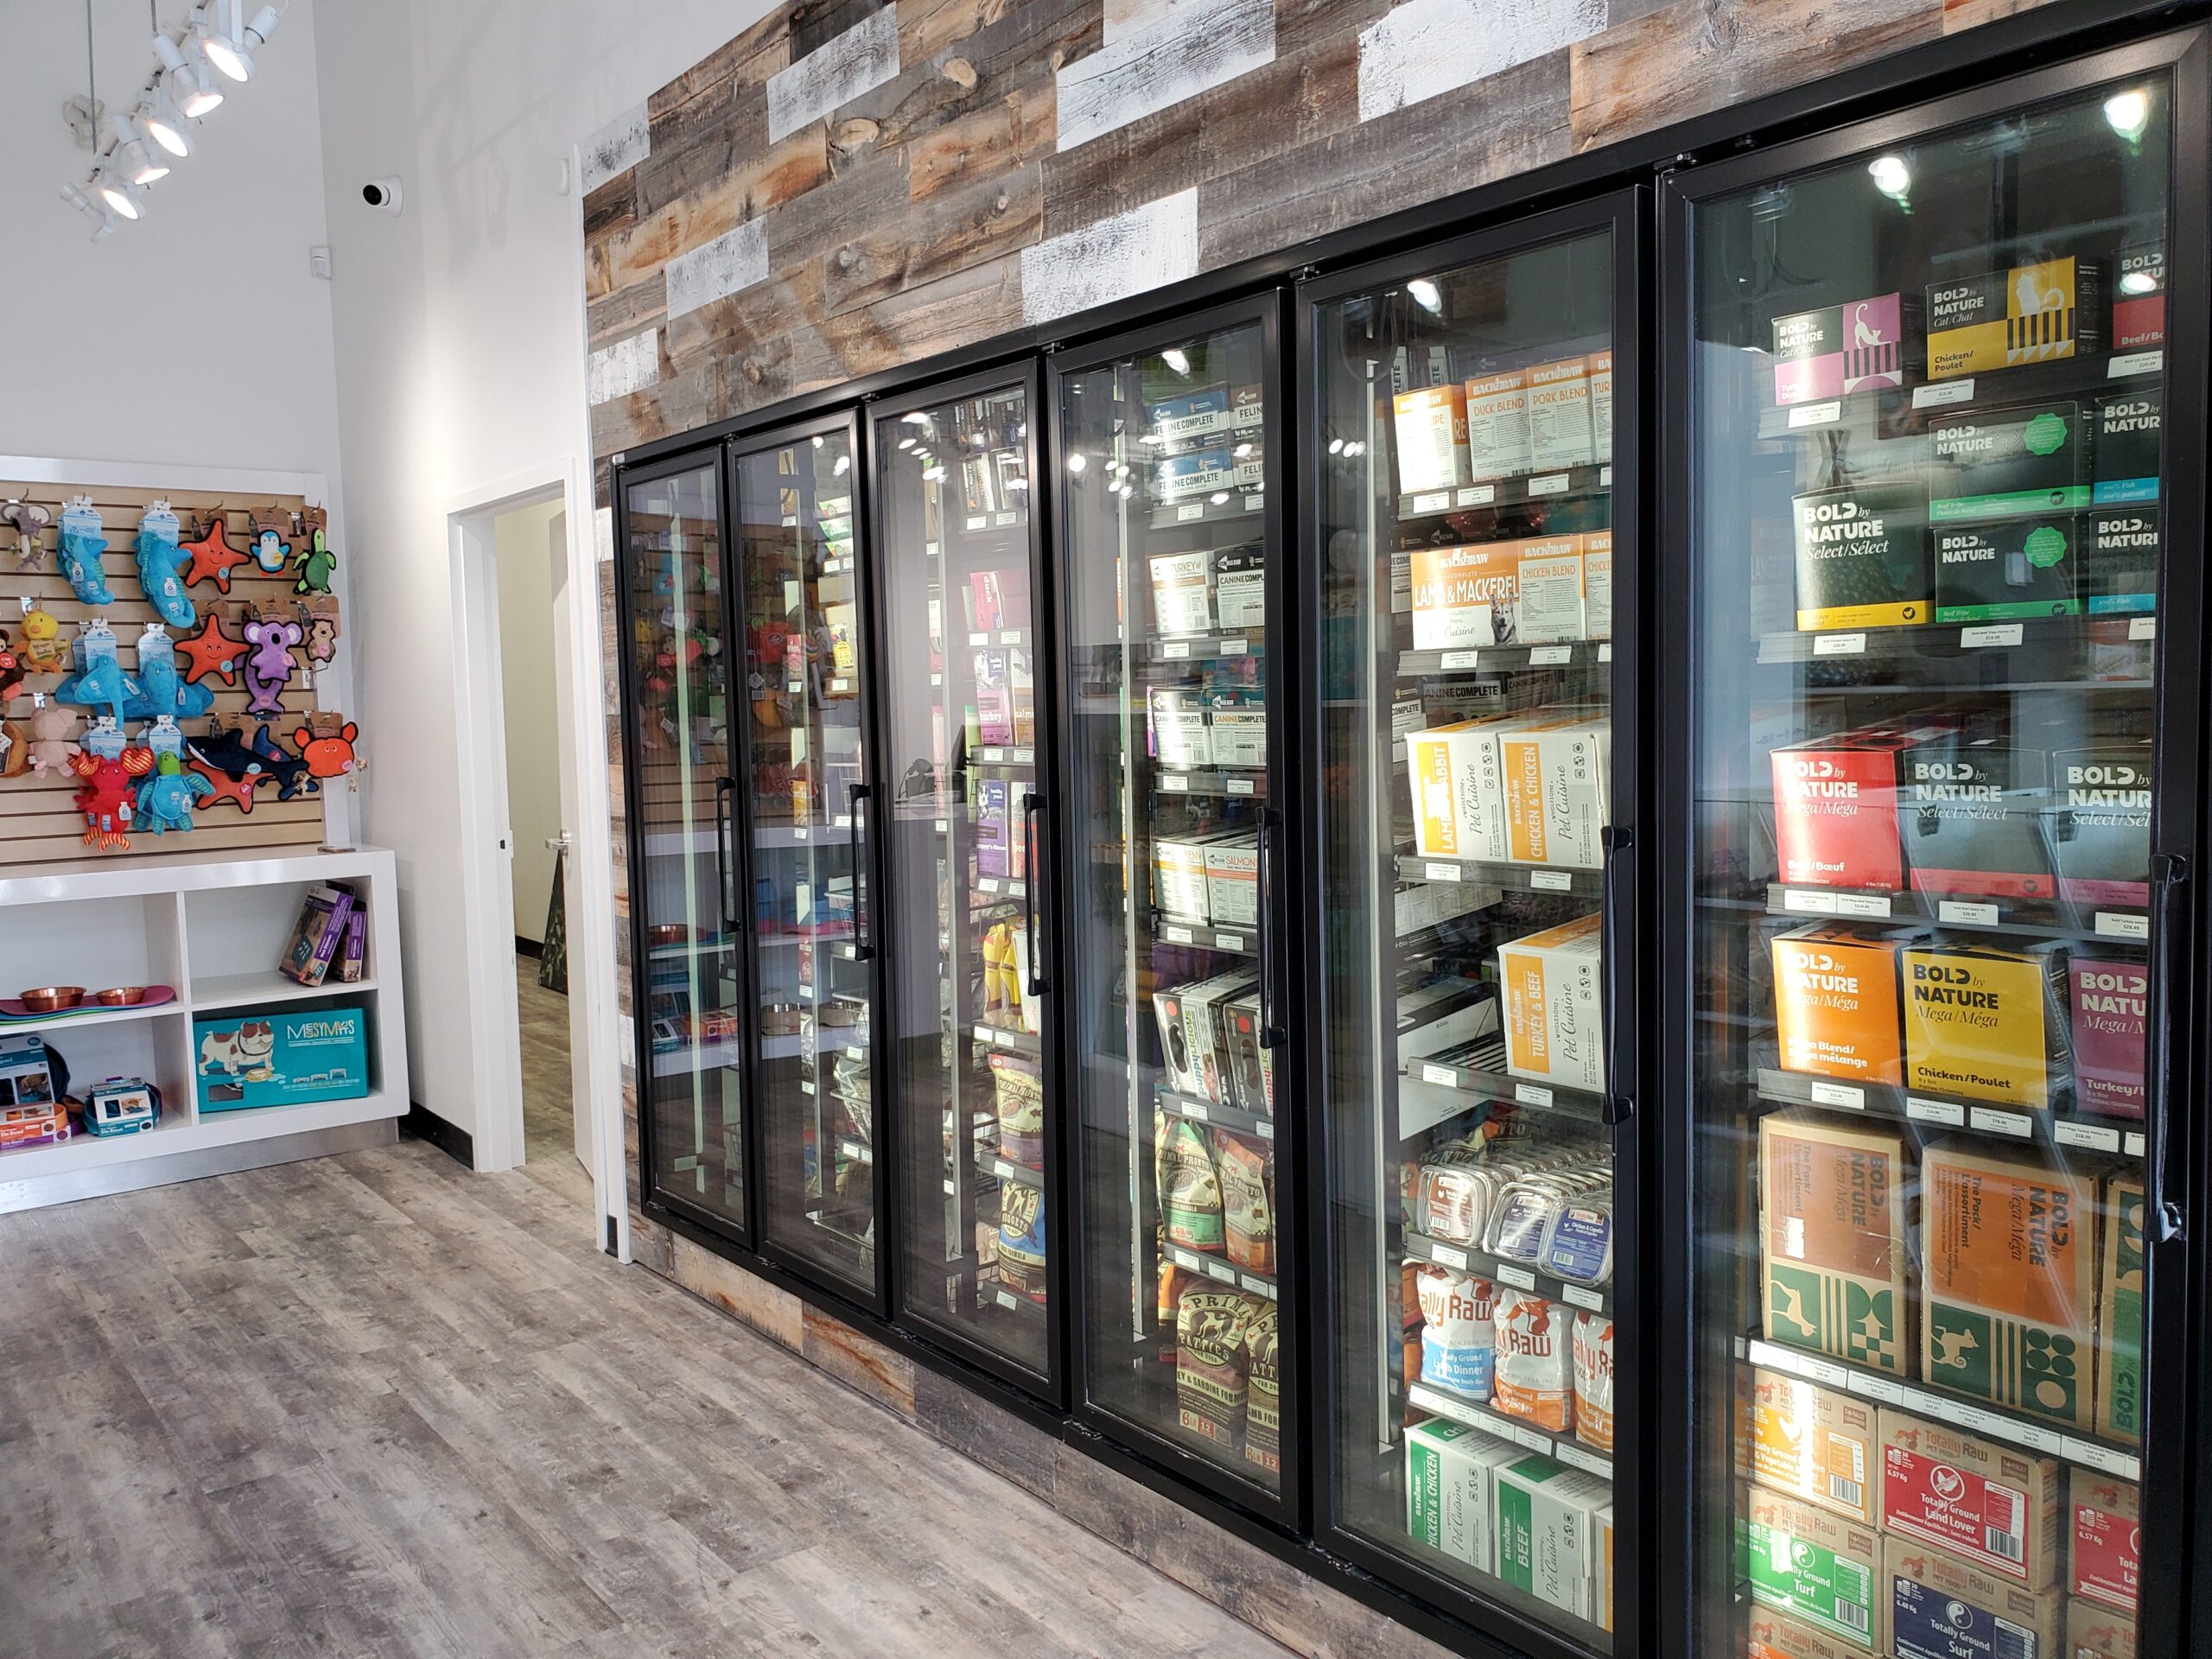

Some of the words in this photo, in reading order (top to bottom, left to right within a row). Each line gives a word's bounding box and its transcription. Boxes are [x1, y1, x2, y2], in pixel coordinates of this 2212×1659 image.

[2122, 253, 2163, 270] BOLD
[1934, 288, 1968, 304] BOLD
[1934, 296, 1985, 316] NATURE
[1779, 322, 1809, 336] BOLD
[1934, 313, 1973, 327] Cat/Chat
[1780, 331, 1823, 348] NATURE
[1935, 350, 1973, 364] Chicken/
[1935, 361, 1963, 372] Poulet
[1533, 391, 1557, 405] PORK
[1559, 386, 1588, 402] BLEND
[1474, 401, 1494, 416] DUCK
[1497, 397, 1524, 413] BLEND
[2104, 402, 2149, 418] BOLD
[2150, 404, 2160, 414] by
[1937, 426, 1975, 442] BOLD
[1936, 436, 1993, 455] NATURE
[1803, 502, 1857, 524] BOLD
[1858, 507, 1871, 518] by
[1803, 519, 1884, 544] NATURE
[2098, 519, 2143, 534] BOLD
[2144, 522, 2152, 531] by
[1805, 539, 1890, 561] Select/Sélect
[1942, 535, 1979, 550] BOLD
[1980, 538, 1987, 547] by
[1942, 548, 1996, 563] NATURE
[1522, 567, 1550, 580] CHICKEN
[1552, 564, 1576, 577] BLEND
[1447, 587, 1456, 604] &
[1457, 575, 1519, 603] MACKEREL
[1445, 626, 1476, 638] Cuisine
[980, 711, 1002, 722] turkey
[1524, 747, 1538, 794] CHICKEN
[1834, 769, 1846, 779] by
[1915, 762, 1974, 780] BOLD
[1974, 769, 1988, 782] by
[2067, 766, 2135, 784] BOLD
[2137, 774, 2152, 785] by
[1466, 763, 1479, 811] Cuisine
[1556, 765, 1569, 814] Cuisine
[1916, 785, 2002, 803] NATURE
[1917, 804, 2007, 820] Select/Sélect
[1470, 815, 1483, 835] Pet
[1529, 810, 1542, 857] CHICKEN
[1559, 817, 1573, 839] Pet
[1226, 855, 1255, 867] SALMON
[1834, 962, 1846, 974] by
[1913, 964, 1970, 984] BOLD
[1972, 976, 1986, 988] by
[1528, 970, 1540, 1000] BEEF
[2081, 971, 2146, 994] BOLD
[1915, 986, 1999, 1009] NATURE
[1560, 982, 1576, 1035] Cuisine
[1916, 1005, 1999, 1028] Mega/Méga
[1531, 1020, 1545, 1058] TURKEY
[1818, 1040, 1855, 1054] Blend/
[1562, 1037, 1579, 1062] Pet
[1820, 1054, 1867, 1068] mélange
[1917, 1066, 2011, 1089] Chicken/Poulet
[1183, 1154, 1210, 1169] PRONTO
[1851, 1152, 1866, 1227] NATURE
[1972, 1176, 1982, 1193] The
[1961, 1173, 1971, 1249] L'assortiment
[1972, 1195, 1982, 1230] Pack/
[2051, 1190, 2069, 1247] BOLD
[1001, 1213, 1028, 1232] NUGGETS
[2010, 1183, 2025, 1262] Mega/Méga
[2029, 1186, 2046, 1268] NATURE
[1448, 1295, 1491, 1321] Raw
[1179, 1333, 1230, 1362] PATTIES
[1510, 1329, 1552, 1357] Raw
[1458, 1354, 1482, 1363] Ground
[1453, 1363, 1484, 1376] Dinner
[1187, 1374, 1192, 1383] &
[1192, 1377, 1220, 1398] SARDINE
[1182, 1411, 1190, 1425] 6
[1199, 1421, 1211, 1433] 12
[1247, 1445, 1252, 1459] 6
[1924, 1429, 1961, 1459] Totally
[1962, 1443, 1987, 1462] Raw
[1427, 1451, 1438, 1497] CHICKEN
[1887, 1469, 1900, 1479] 6.57
[1431, 1499, 1439, 1508] &
[1452, 1481, 1462, 1524] Cuisine
[1921, 1492, 1948, 1512] Totally
[1949, 1503, 1980, 1522] Ground
[1815, 1516, 1836, 1536] Raw
[1924, 1506, 1948, 1525] Land
[1949, 1516, 1976, 1535] Lover
[1452, 1525, 1465, 1551] Pet
[1517, 1523, 1529, 1567] BEEF
[2078, 1530, 2092, 1541] 6.57
[1546, 1526, 1557, 1573] Cuisine
[1546, 1574, 1559, 1599] Pet
[1803, 1570, 1830, 1587] Ground
[1931, 1558, 1967, 1588] Totally
[1968, 1575, 1994, 1595] Raw
[1794, 1579, 1815, 1598] Turf
[1779, 1624, 1810, 1652] Totally
[1812, 1638, 1834, 1658] Raw
[1930, 1618, 1959, 1640] Totally
[1959, 1632, 1990, 1651] Ground
[1948, 1640, 1974, 1659] Surf
